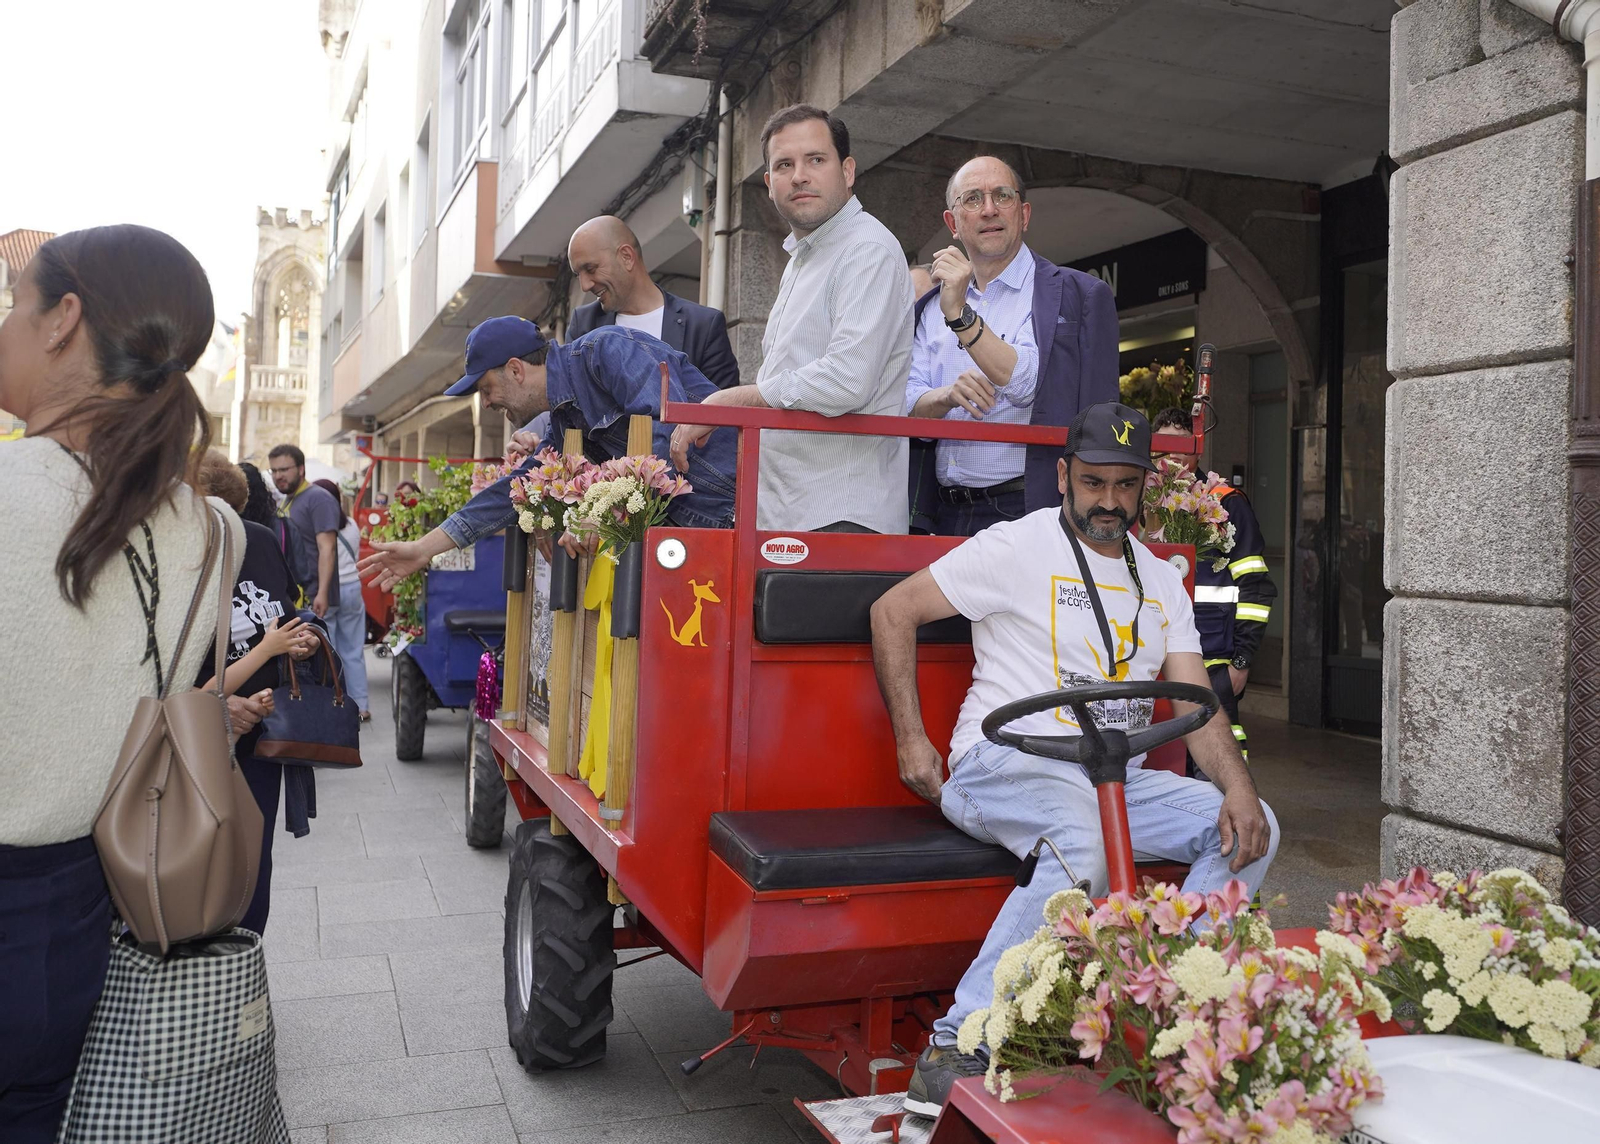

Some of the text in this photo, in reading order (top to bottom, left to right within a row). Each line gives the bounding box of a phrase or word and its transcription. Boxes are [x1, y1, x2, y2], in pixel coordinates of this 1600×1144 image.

[1158, 285, 1171, 297] ONLY
[1175, 280, 1189, 293] SONS
[766, 543, 806, 554] NOVO AGRO
